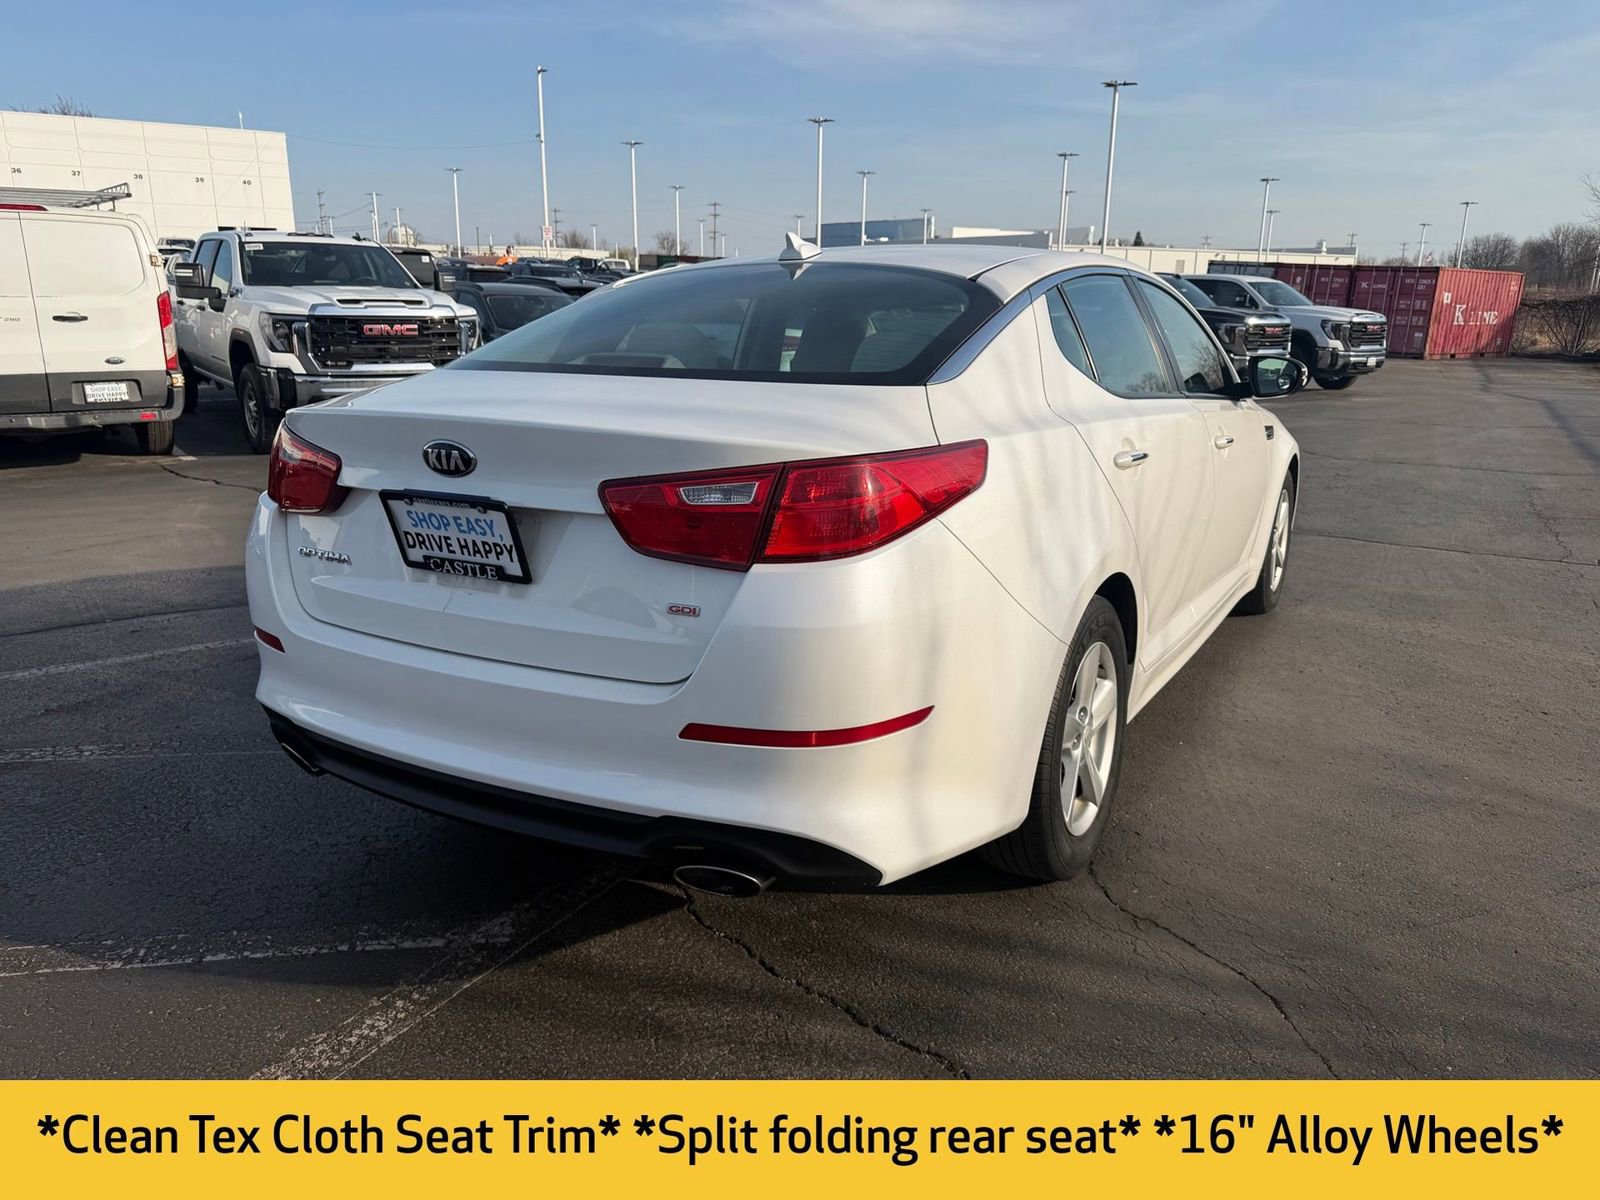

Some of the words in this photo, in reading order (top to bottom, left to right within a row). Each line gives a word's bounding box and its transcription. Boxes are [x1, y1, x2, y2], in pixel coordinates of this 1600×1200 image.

[11, 167, 22, 175] 36
[1469, 311, 1499, 326] LINE
[363, 324, 419, 336] GMC
[426, 448, 466, 471] KIA
[406, 509, 449, 532] SHOP
[451, 515, 504, 543] EASY,
[297, 546, 352, 566] OPTIMA
[402, 530, 456, 555] DRIVE
[457, 536, 515, 563] HAPPY
[430, 557, 499, 580] CASTLE
[669, 605, 697, 615] GDI
